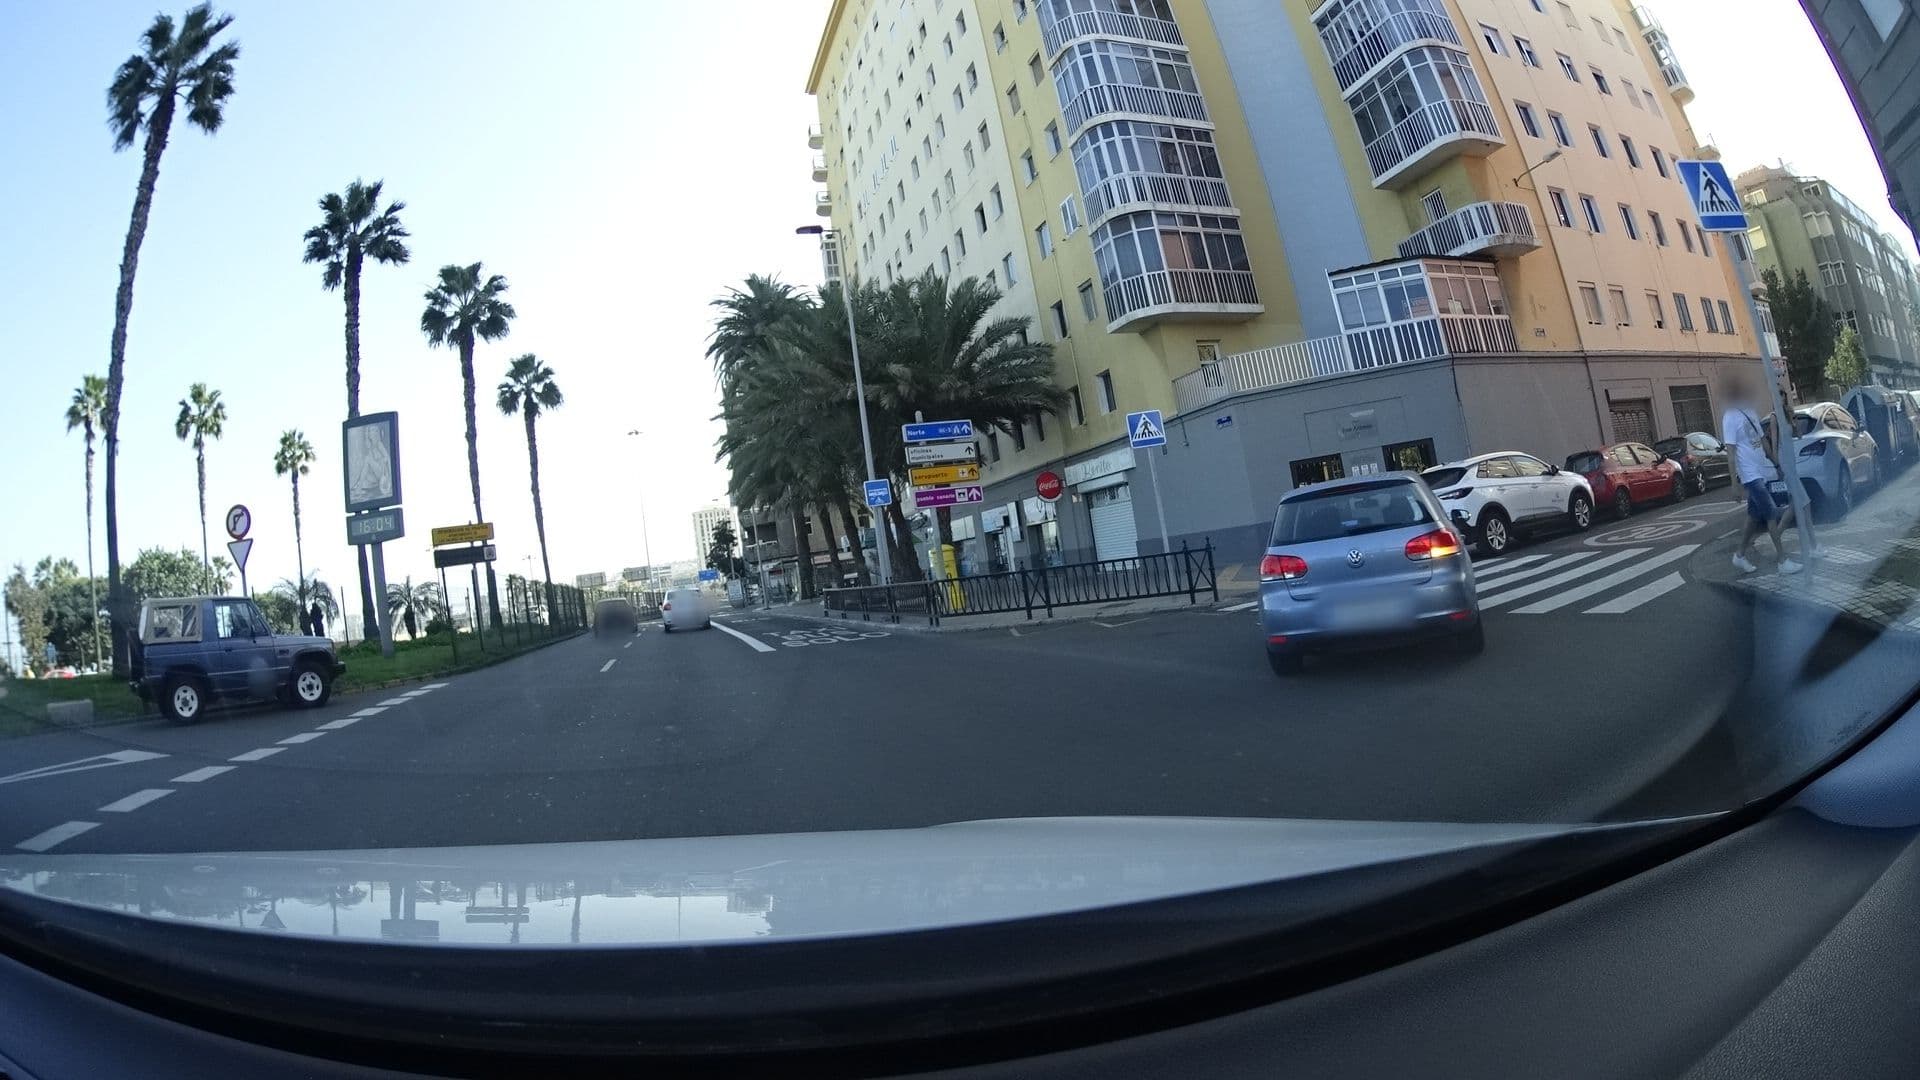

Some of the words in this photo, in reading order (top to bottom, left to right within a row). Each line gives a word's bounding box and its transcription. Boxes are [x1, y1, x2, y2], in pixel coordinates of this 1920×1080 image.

[914, 472, 948, 480] aeropuerto
[917, 494, 934, 503] pueblo
[359, 515, 393, 534] 16:04
[781, 631, 892, 647] SOLO
